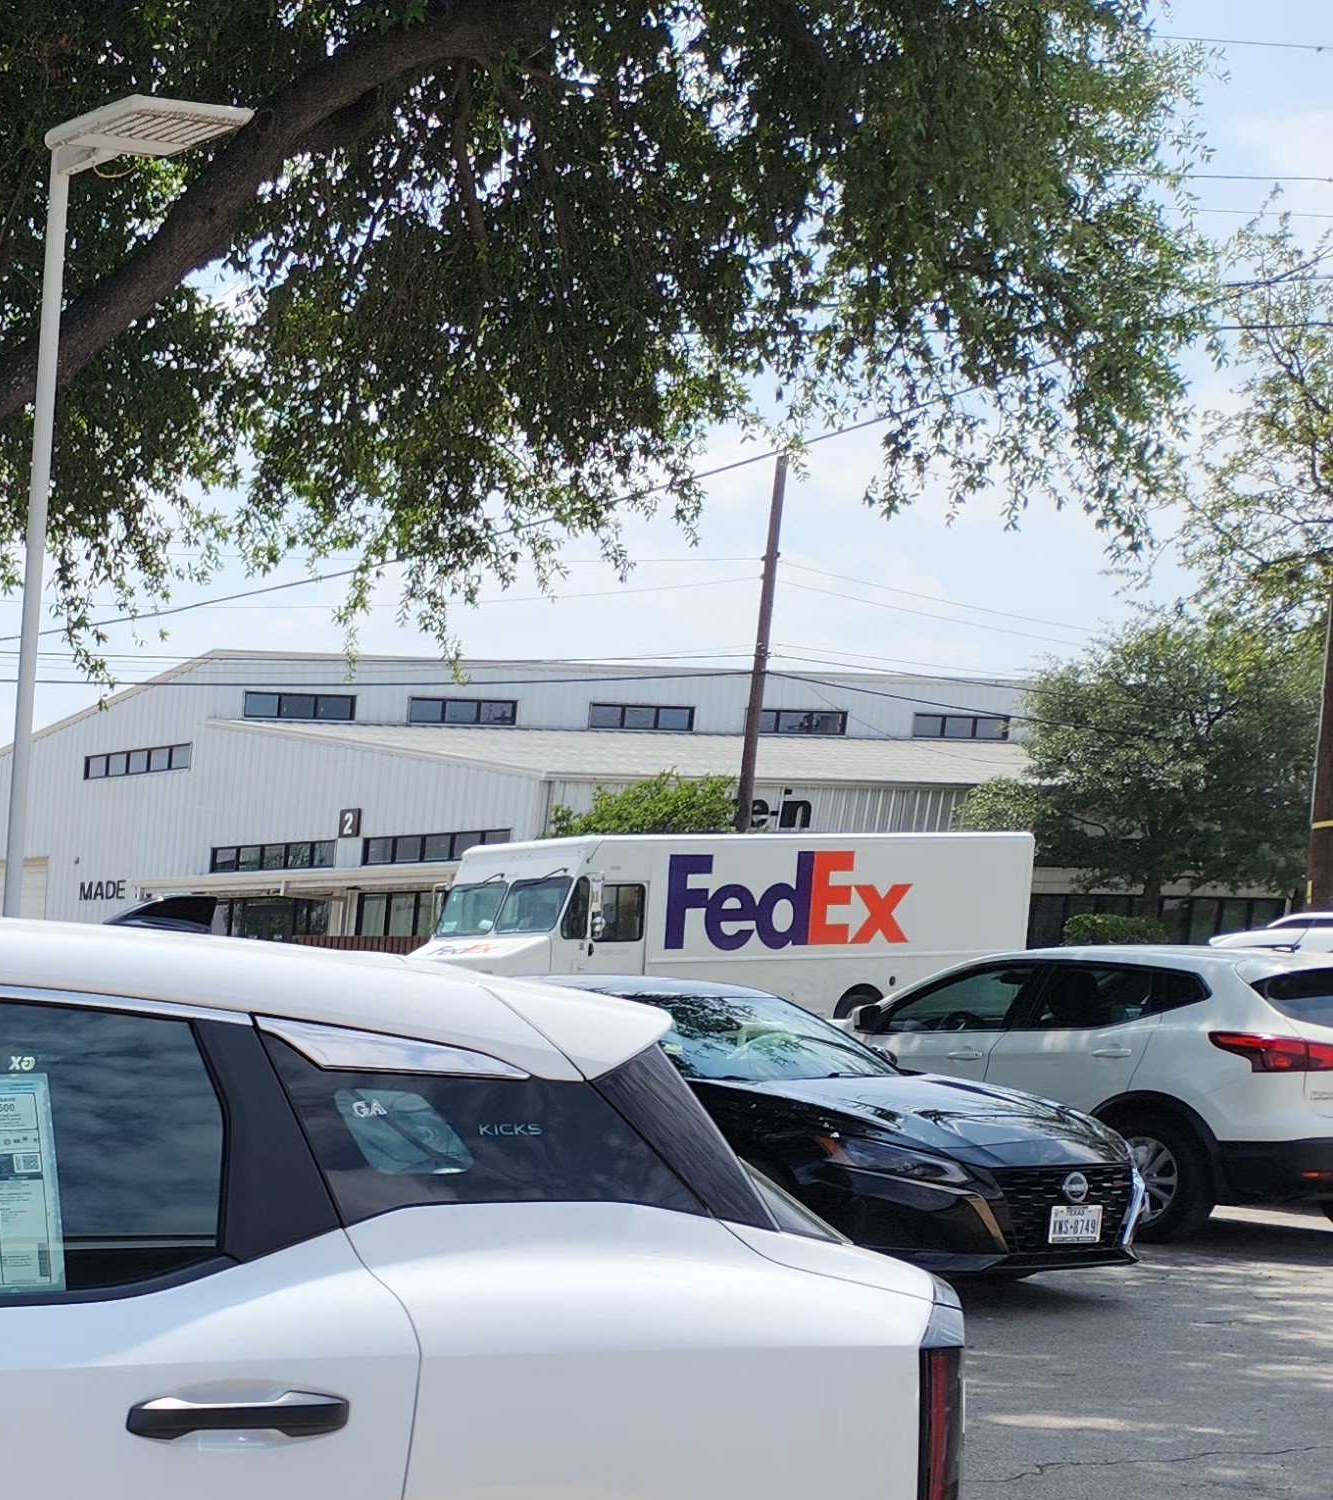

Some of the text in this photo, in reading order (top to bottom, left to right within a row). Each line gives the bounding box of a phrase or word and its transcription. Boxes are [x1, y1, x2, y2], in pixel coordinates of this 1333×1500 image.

[342, 812, 354, 836] 2
[79, 880, 126, 900] MADE
[664, 850, 913, 951] FedEx
[478, 1123, 542, 1136] KICKS
